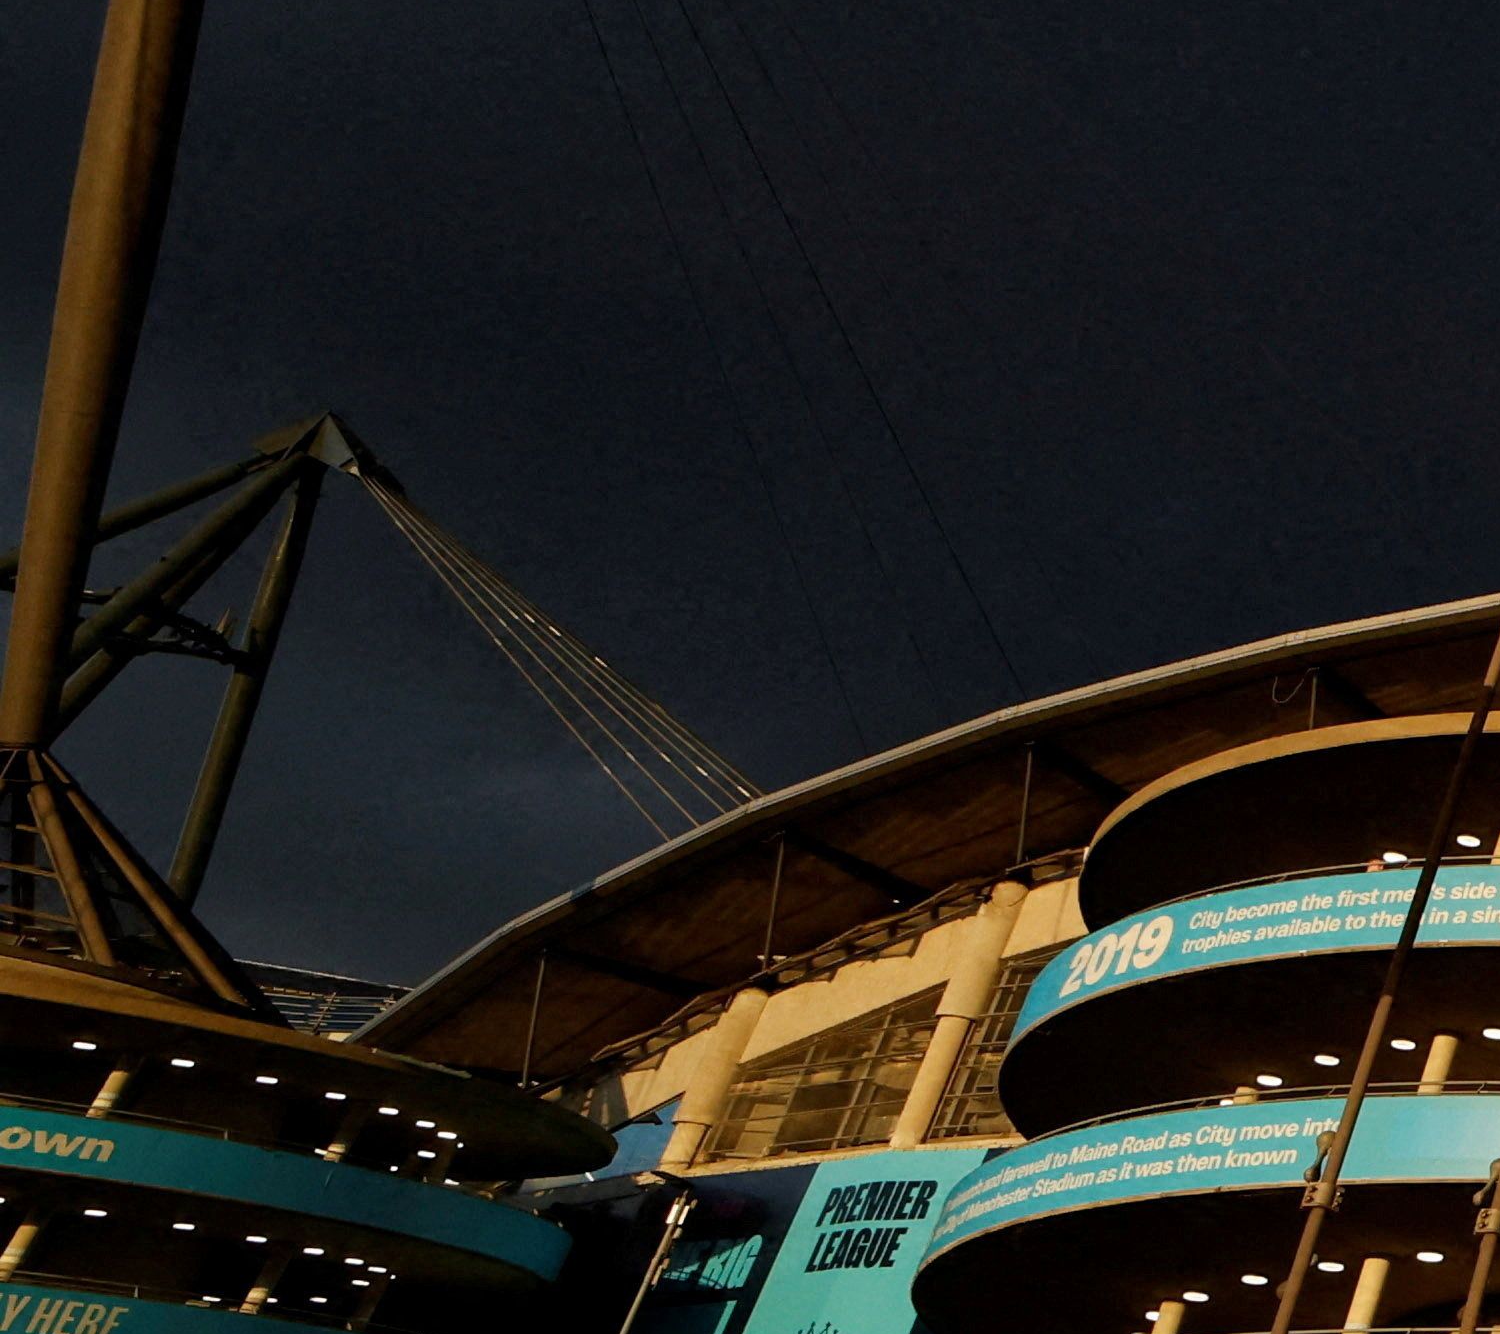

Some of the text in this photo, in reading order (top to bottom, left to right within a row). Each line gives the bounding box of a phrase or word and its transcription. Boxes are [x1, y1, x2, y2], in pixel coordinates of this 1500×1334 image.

[1190, 910, 1224, 933] City
[1224, 900, 1300, 925] become
[1300, 894, 1333, 913] the
[1336, 887, 1381, 908] first
[1450, 880, 1497, 901] side
[1060, 915, 1174, 999] 2019
[1182, 929, 1252, 959] trophies
[1255, 912, 1342, 942] available
[1345, 912, 1368, 931] to
[1429, 908, 1449, 926] in
[1453, 911, 1467, 926] a
[1119, 1121, 1299, 1156] Road as City move
[1134, 1146, 1298, 1179] was then known
[816, 1180, 938, 1228] PREMIER
[805, 1228, 907, 1273] LEAGUE
